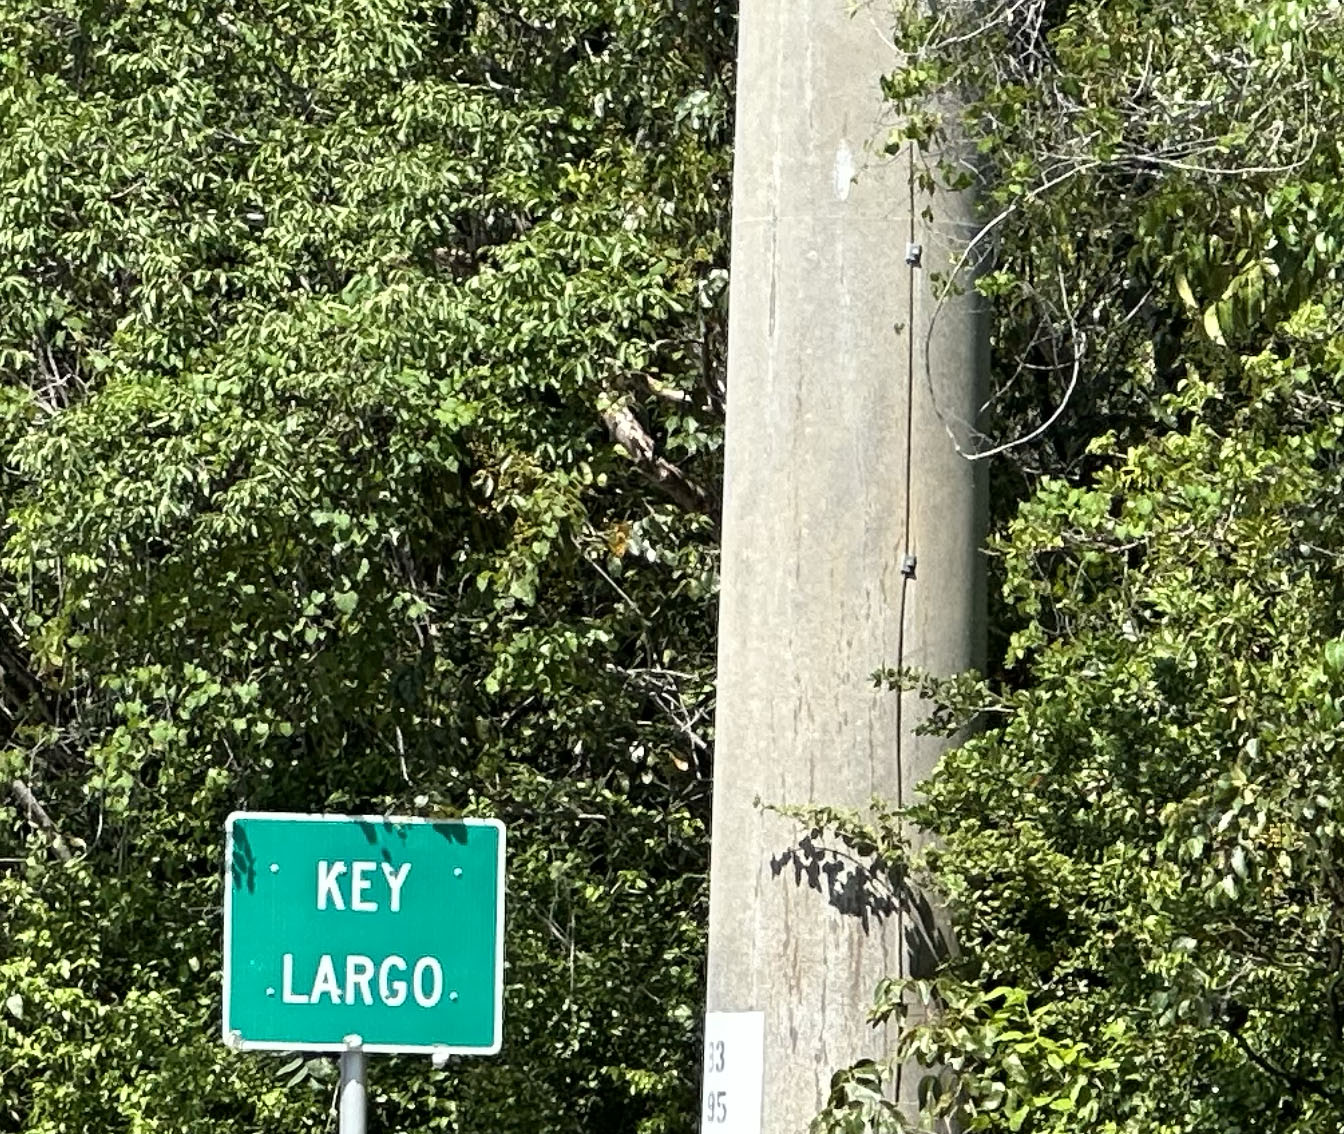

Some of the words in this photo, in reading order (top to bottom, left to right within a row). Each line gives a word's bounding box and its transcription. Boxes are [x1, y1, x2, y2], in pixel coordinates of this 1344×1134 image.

[317, 860, 412, 912] KEY
[282, 953, 444, 1007] LARGO
[707, 1091, 727, 1123] 95
